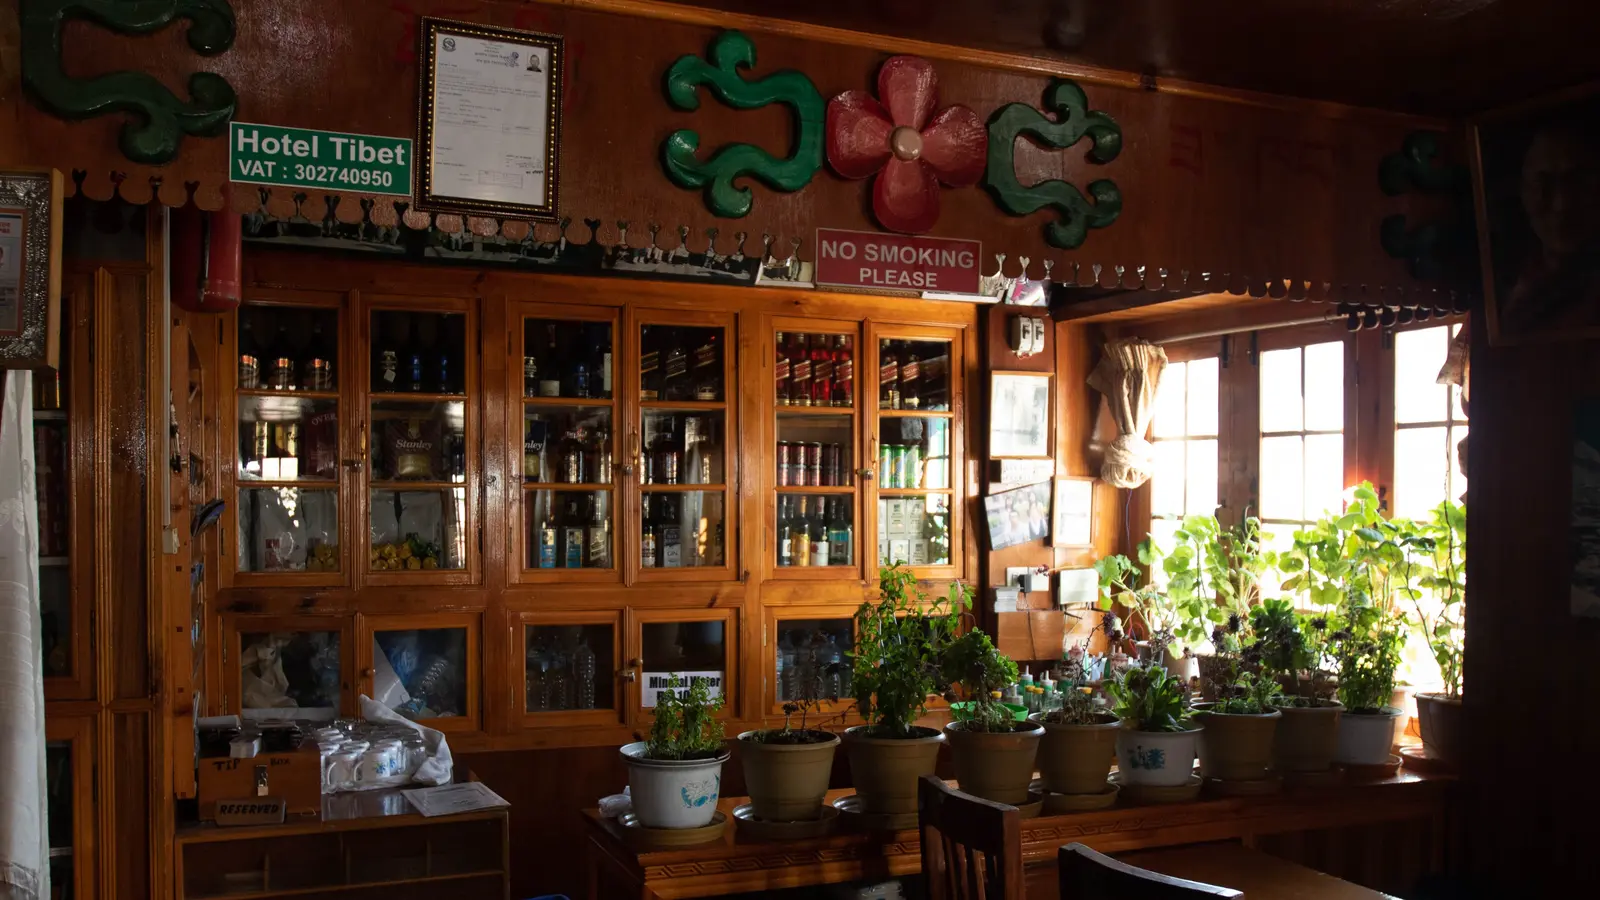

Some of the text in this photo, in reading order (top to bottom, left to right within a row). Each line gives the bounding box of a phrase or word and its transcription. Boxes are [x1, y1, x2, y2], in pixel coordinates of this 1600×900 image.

[237, 128, 319, 158] Hotel
[328, 136, 406, 166] Tibet
[237, 159, 276, 177] VAT
[294, 164, 393, 187] 302740950
[821, 240, 974, 269] NO SMOKING
[859, 267, 938, 288] PLEASE
[395, 438, 433, 451] Stanley
[524, 439, 543, 451] nley
[212, 758, 291, 770] TIP BOX
[220, 804, 279, 815] RESERVED
